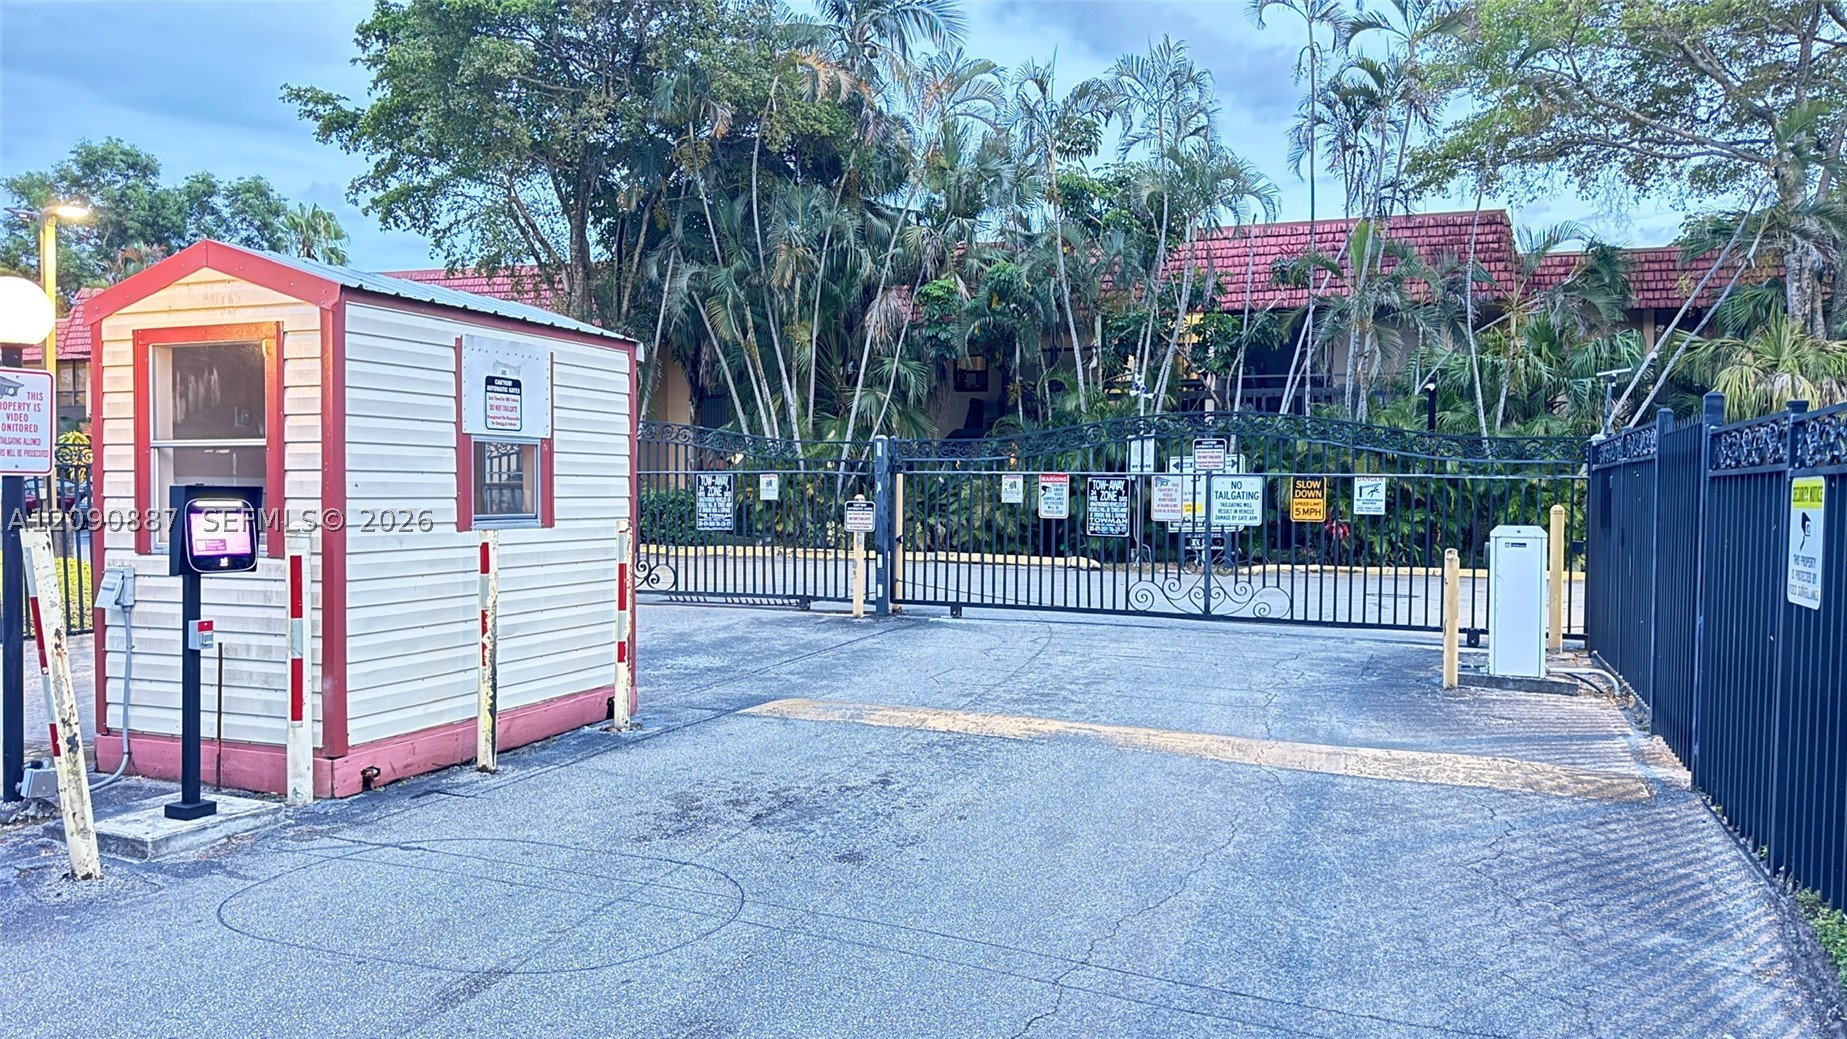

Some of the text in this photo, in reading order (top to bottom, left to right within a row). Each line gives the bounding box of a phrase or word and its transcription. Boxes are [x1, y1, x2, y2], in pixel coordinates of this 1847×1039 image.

[28, 392, 44, 400] THIS
[0, 402, 42, 412] ROPERTY IS
[6, 412, 28, 422] VIDEO
[2, 422, 38, 432] ONITORED
[24, 438, 42, 446] ALLOWED
[6, 448, 16, 456] WILL
[24, 450, 48, 458] PROSECUTED
[1092, 480, 1126, 490] TOW-AWAY
[1230, 480, 1242, 490] NO
[1296, 480, 1322, 488] SLOW
[708, 486, 722, 496] ZONE
[1100, 490, 1118, 502] ZONE
[1214, 490, 1260, 500] TAILGATING
[1294, 490, 1322, 498] DOWN
[1794, 486, 1824, 502] SECURITY NOTICE
[1296, 508, 1322, 516] 5 MPH
